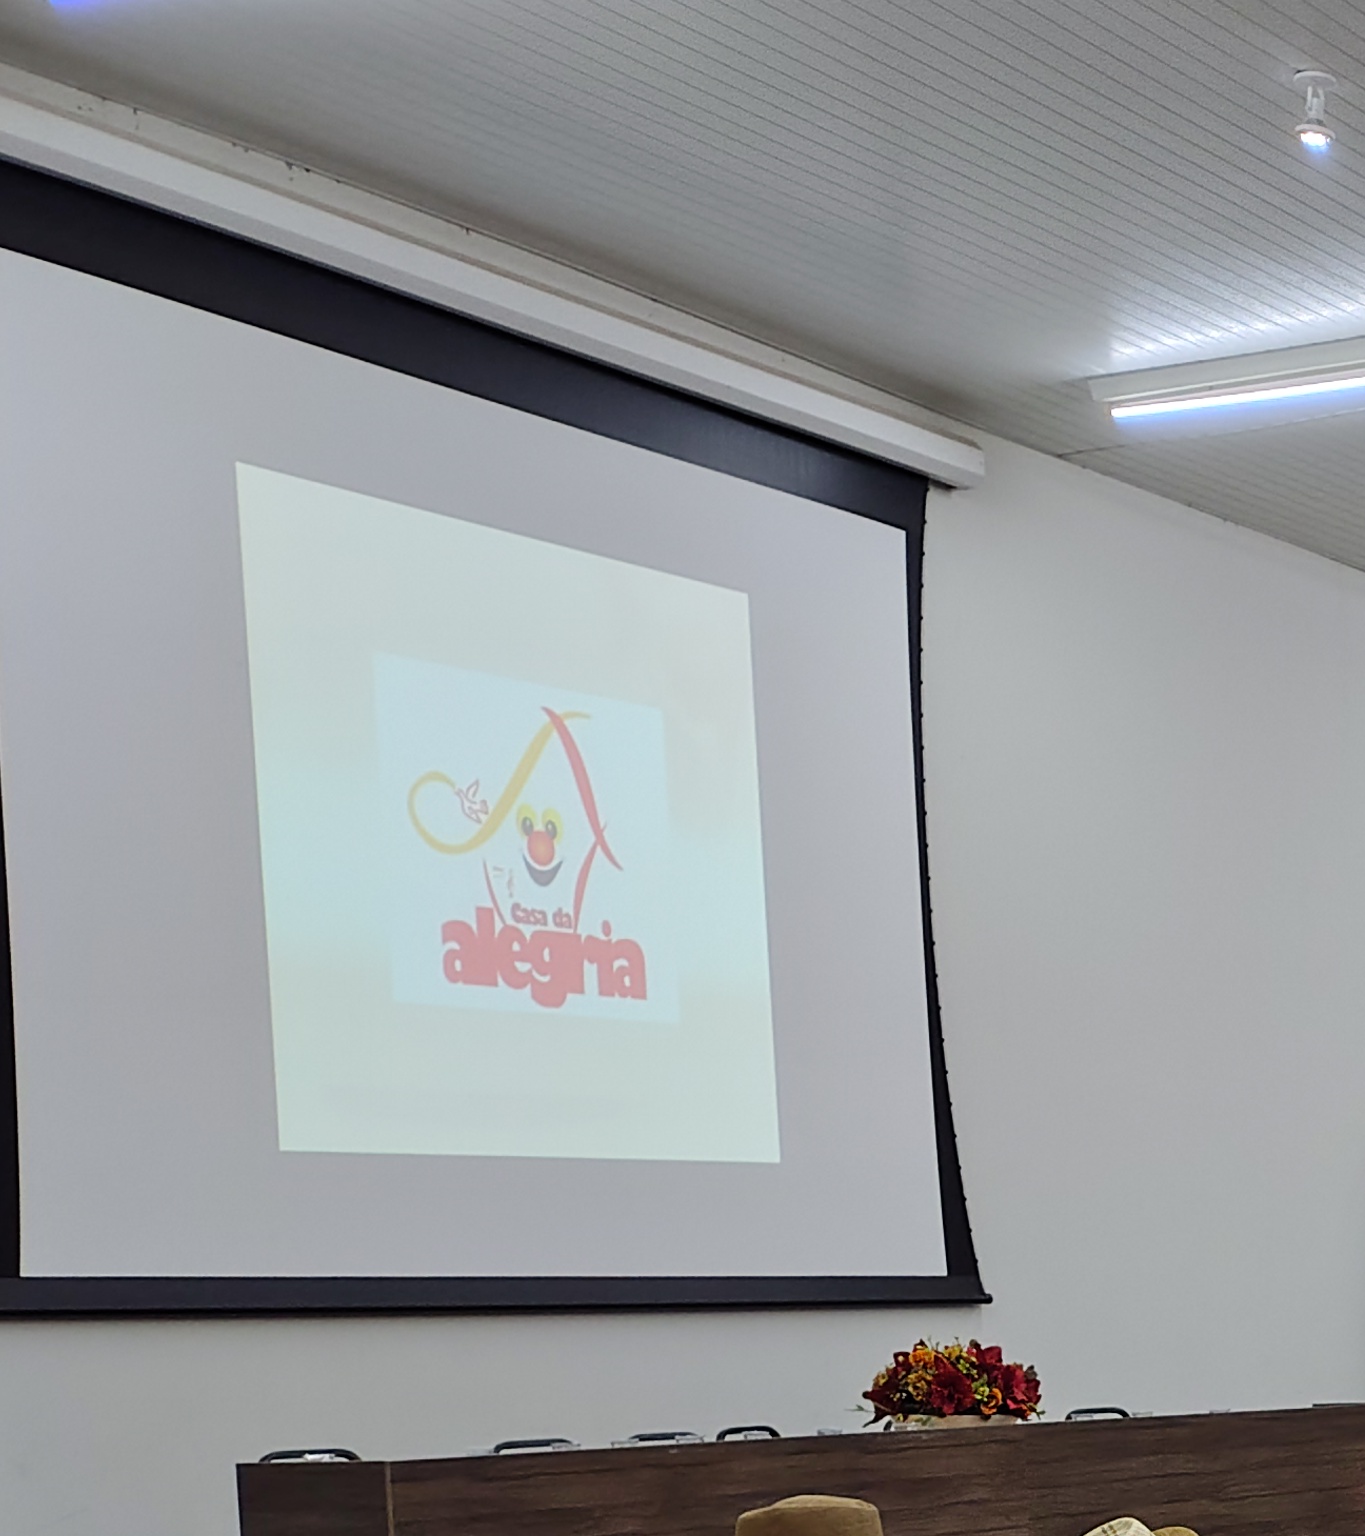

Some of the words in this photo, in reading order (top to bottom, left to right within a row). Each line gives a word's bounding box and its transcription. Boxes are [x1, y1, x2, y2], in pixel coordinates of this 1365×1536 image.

[511, 903, 548, 927] Casa
[552, 907, 573, 929] da
[441, 906, 648, 1008] alegria
